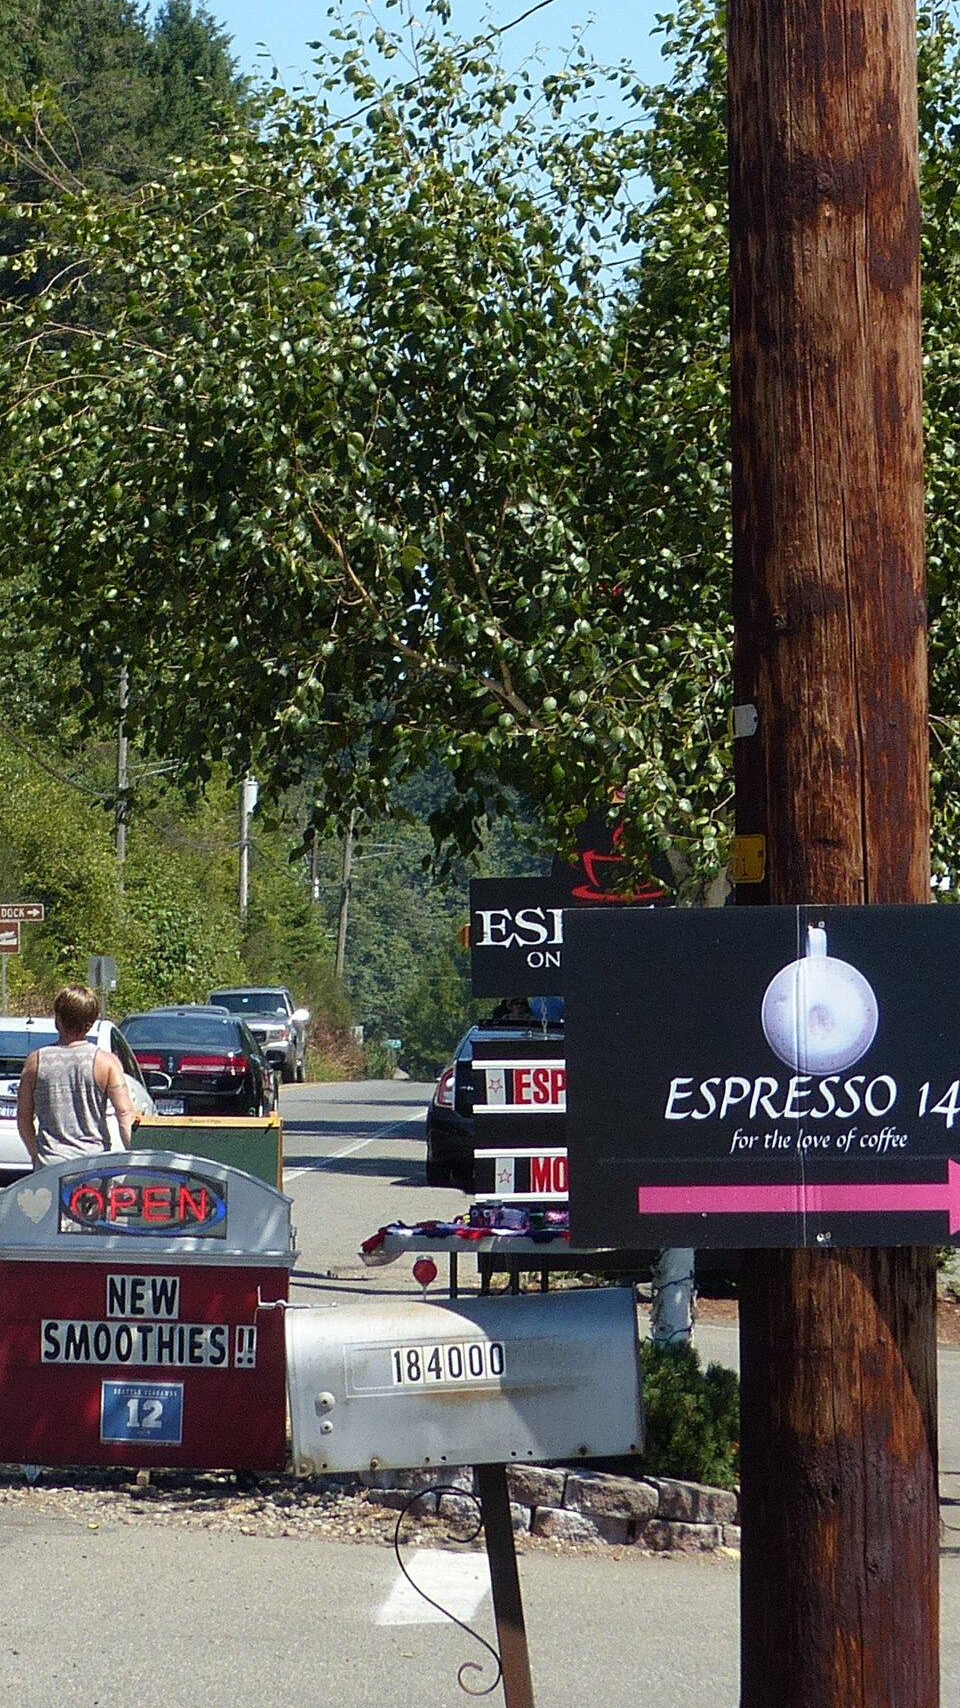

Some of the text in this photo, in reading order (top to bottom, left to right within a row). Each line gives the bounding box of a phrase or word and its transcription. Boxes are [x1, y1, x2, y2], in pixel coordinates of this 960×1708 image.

[1, 908, 25, 918] DOCK
[514, 1068, 567, 1105] ESP
[664, 1075, 898, 1120] ESPRESSO
[730, 1127, 908, 1154] for the love of coffee
[531, 1156, 569, 1193] MO
[69, 1186, 207, 1223] OPEN
[109, 1277, 178, 1316] NEW
[43, 1322, 226, 1365] SMOOTHIES
[394, 1343, 505, 1383] 184000
[126, 1398, 164, 1428] 12
